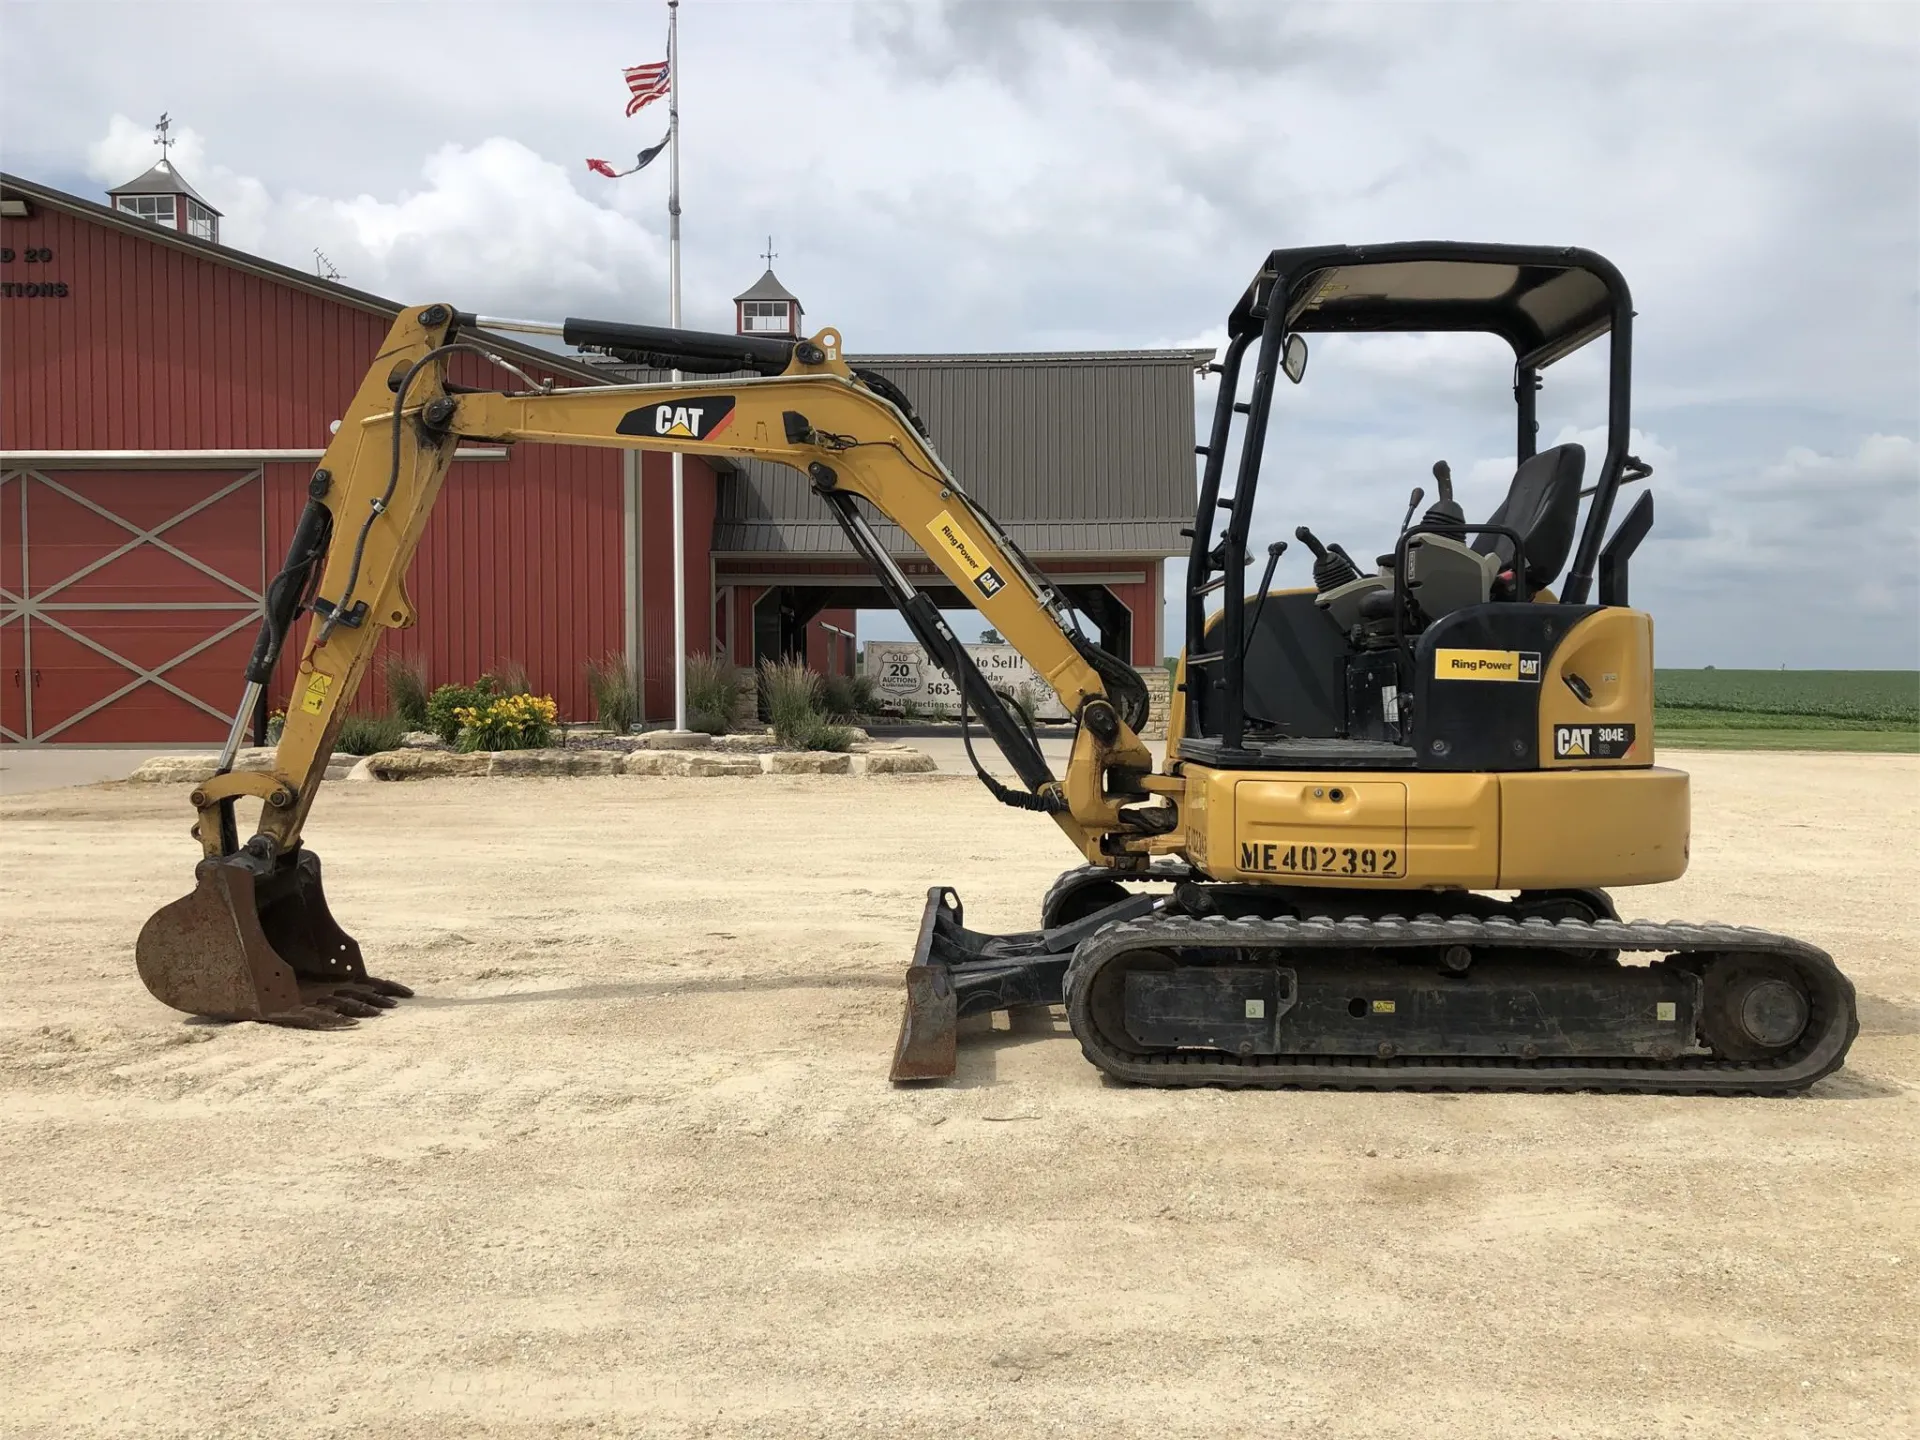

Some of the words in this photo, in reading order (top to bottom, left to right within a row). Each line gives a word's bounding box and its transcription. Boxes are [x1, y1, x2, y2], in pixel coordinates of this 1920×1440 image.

[24, 247, 53, 263] 20
[655, 405, 704, 437] CAT
[941, 525, 959, 547] Ring
[956, 542, 979, 570] Power
[979, 572, 1001, 592] CAT
[892, 654, 908, 662] OLD
[976, 656, 989, 668] to
[991, 654, 1024, 669] Sell!
[1451, 659, 1477, 670] Ring
[1479, 659, 1512, 670] Power
[890, 664, 910, 677] 20
[1520, 659, 1538, 674] CAT
[882, 676, 917, 684] AUCTIONS
[1557, 728, 1593, 755] CAT
[1241, 842, 1397, 875] ME402392
